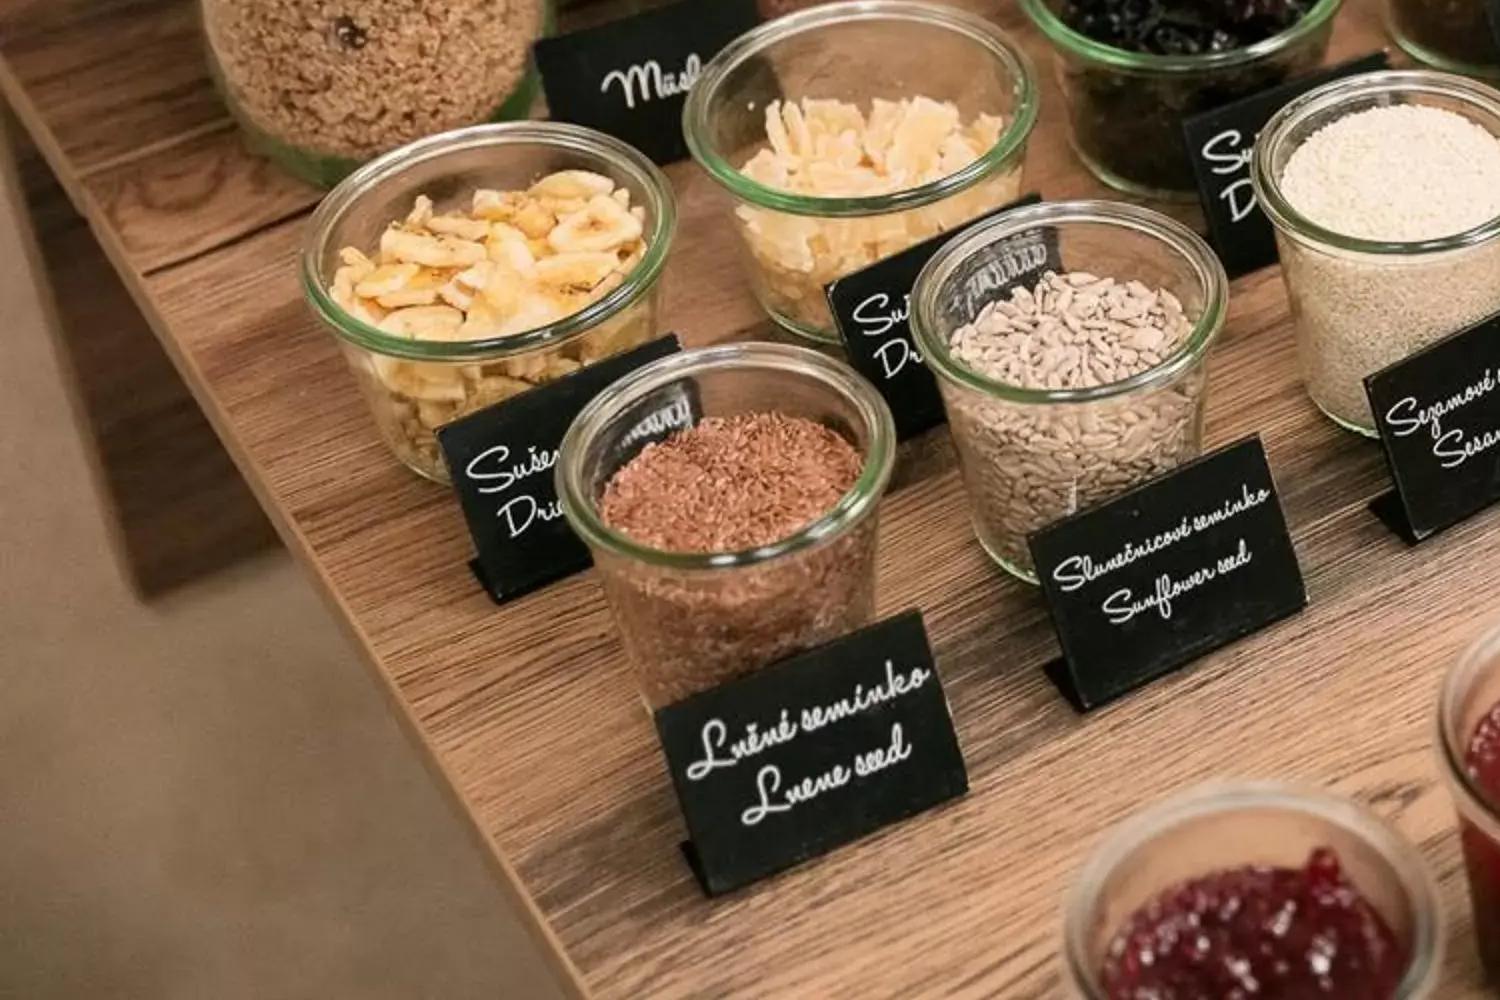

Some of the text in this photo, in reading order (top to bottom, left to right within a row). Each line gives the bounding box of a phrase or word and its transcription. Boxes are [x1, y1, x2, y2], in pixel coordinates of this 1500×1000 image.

[601, 52, 701, 109] Müsl
[1386, 368, 1496, 439] Sezamové
[1053, 483, 1271, 591] Slunečnicové semínko
[1102, 538, 1252, 623] Sunflower seed
[687, 659, 930, 780] Lněné semínko
[855, 722, 912, 776] seed
